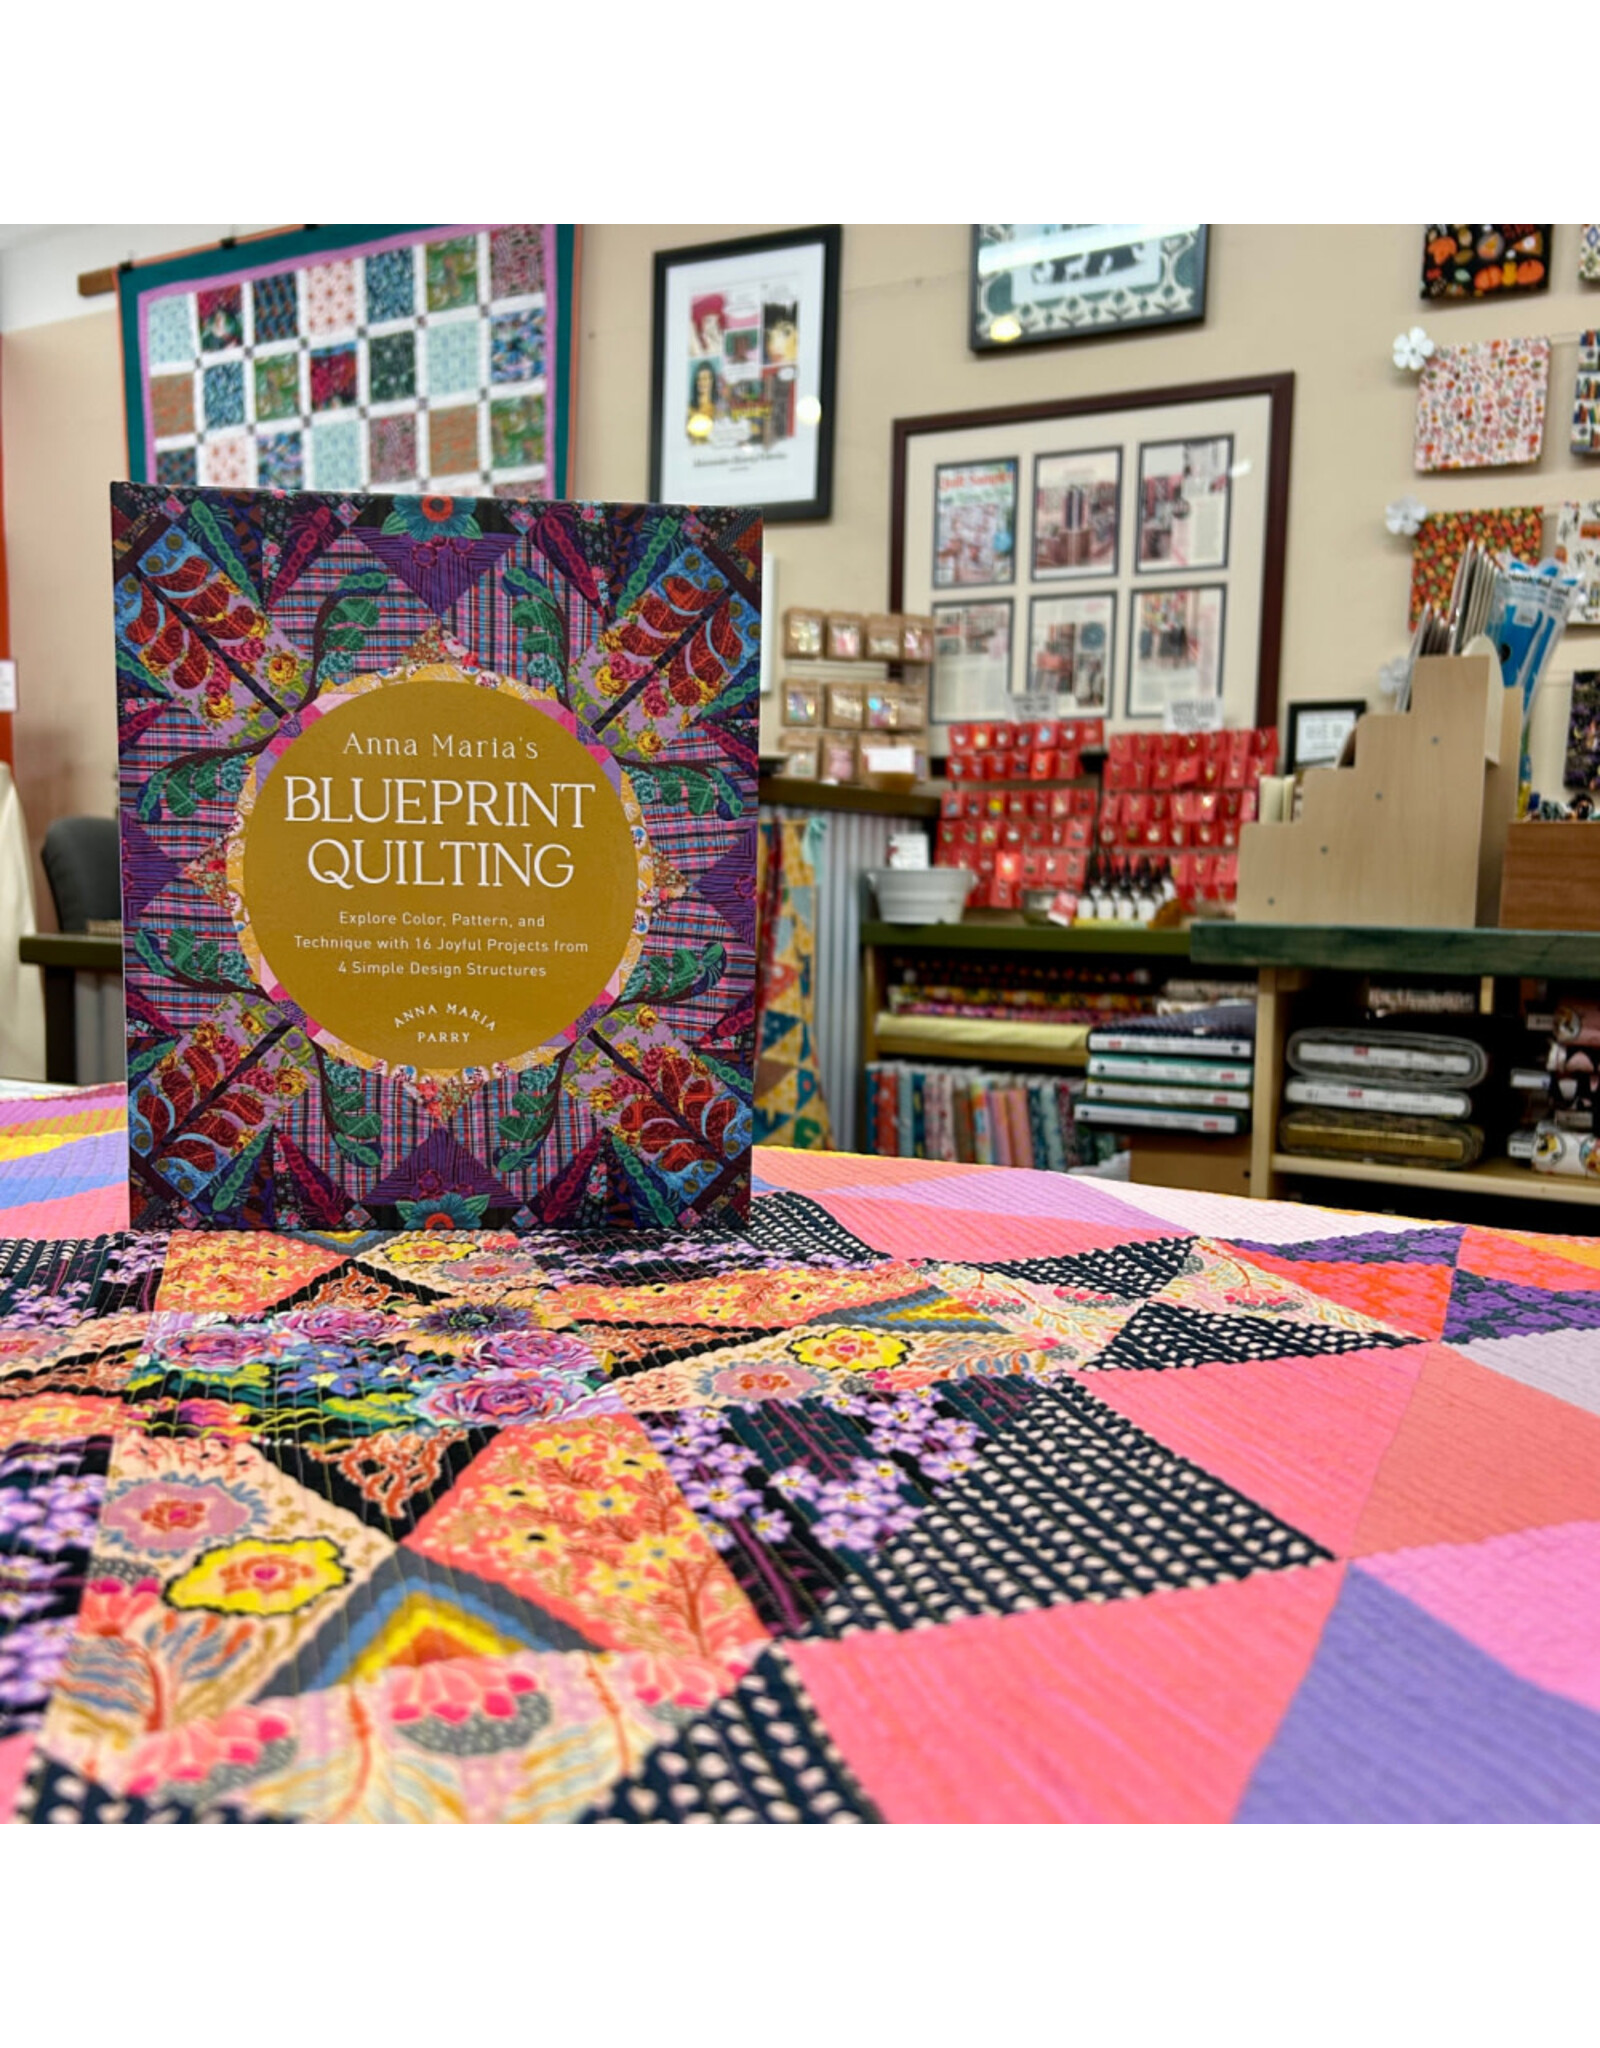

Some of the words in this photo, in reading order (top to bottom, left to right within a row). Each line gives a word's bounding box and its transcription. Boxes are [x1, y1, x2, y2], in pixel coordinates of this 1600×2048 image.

[343, 732, 418, 756] Anna
[432, 734, 538, 759] Maria's
[284, 775, 595, 829] BLUEPRINT
[308, 838, 575, 890] QUILTING
[339, 911, 397, 927] Explore
[402, 912, 447, 928] Color,
[452, 912, 514, 928] Pattern,
[518, 915, 545, 928] and
[294, 935, 372, 952] Technique
[377, 937, 409, 950] with
[415, 937, 432, 950] 16
[436, 937, 482, 953] Joyful
[487, 938, 549, 954] Projects
[554, 940, 589, 952] from
[338, 961, 347, 973] 4
[352, 961, 404, 977] Simple
[410, 962, 462, 978] Design
[466, 962, 547, 977] Structures
[394, 1003, 438, 1028] ANNA
[445, 1003, 497, 1031] MARIA
[417, 1031, 470, 1044] PARRY
